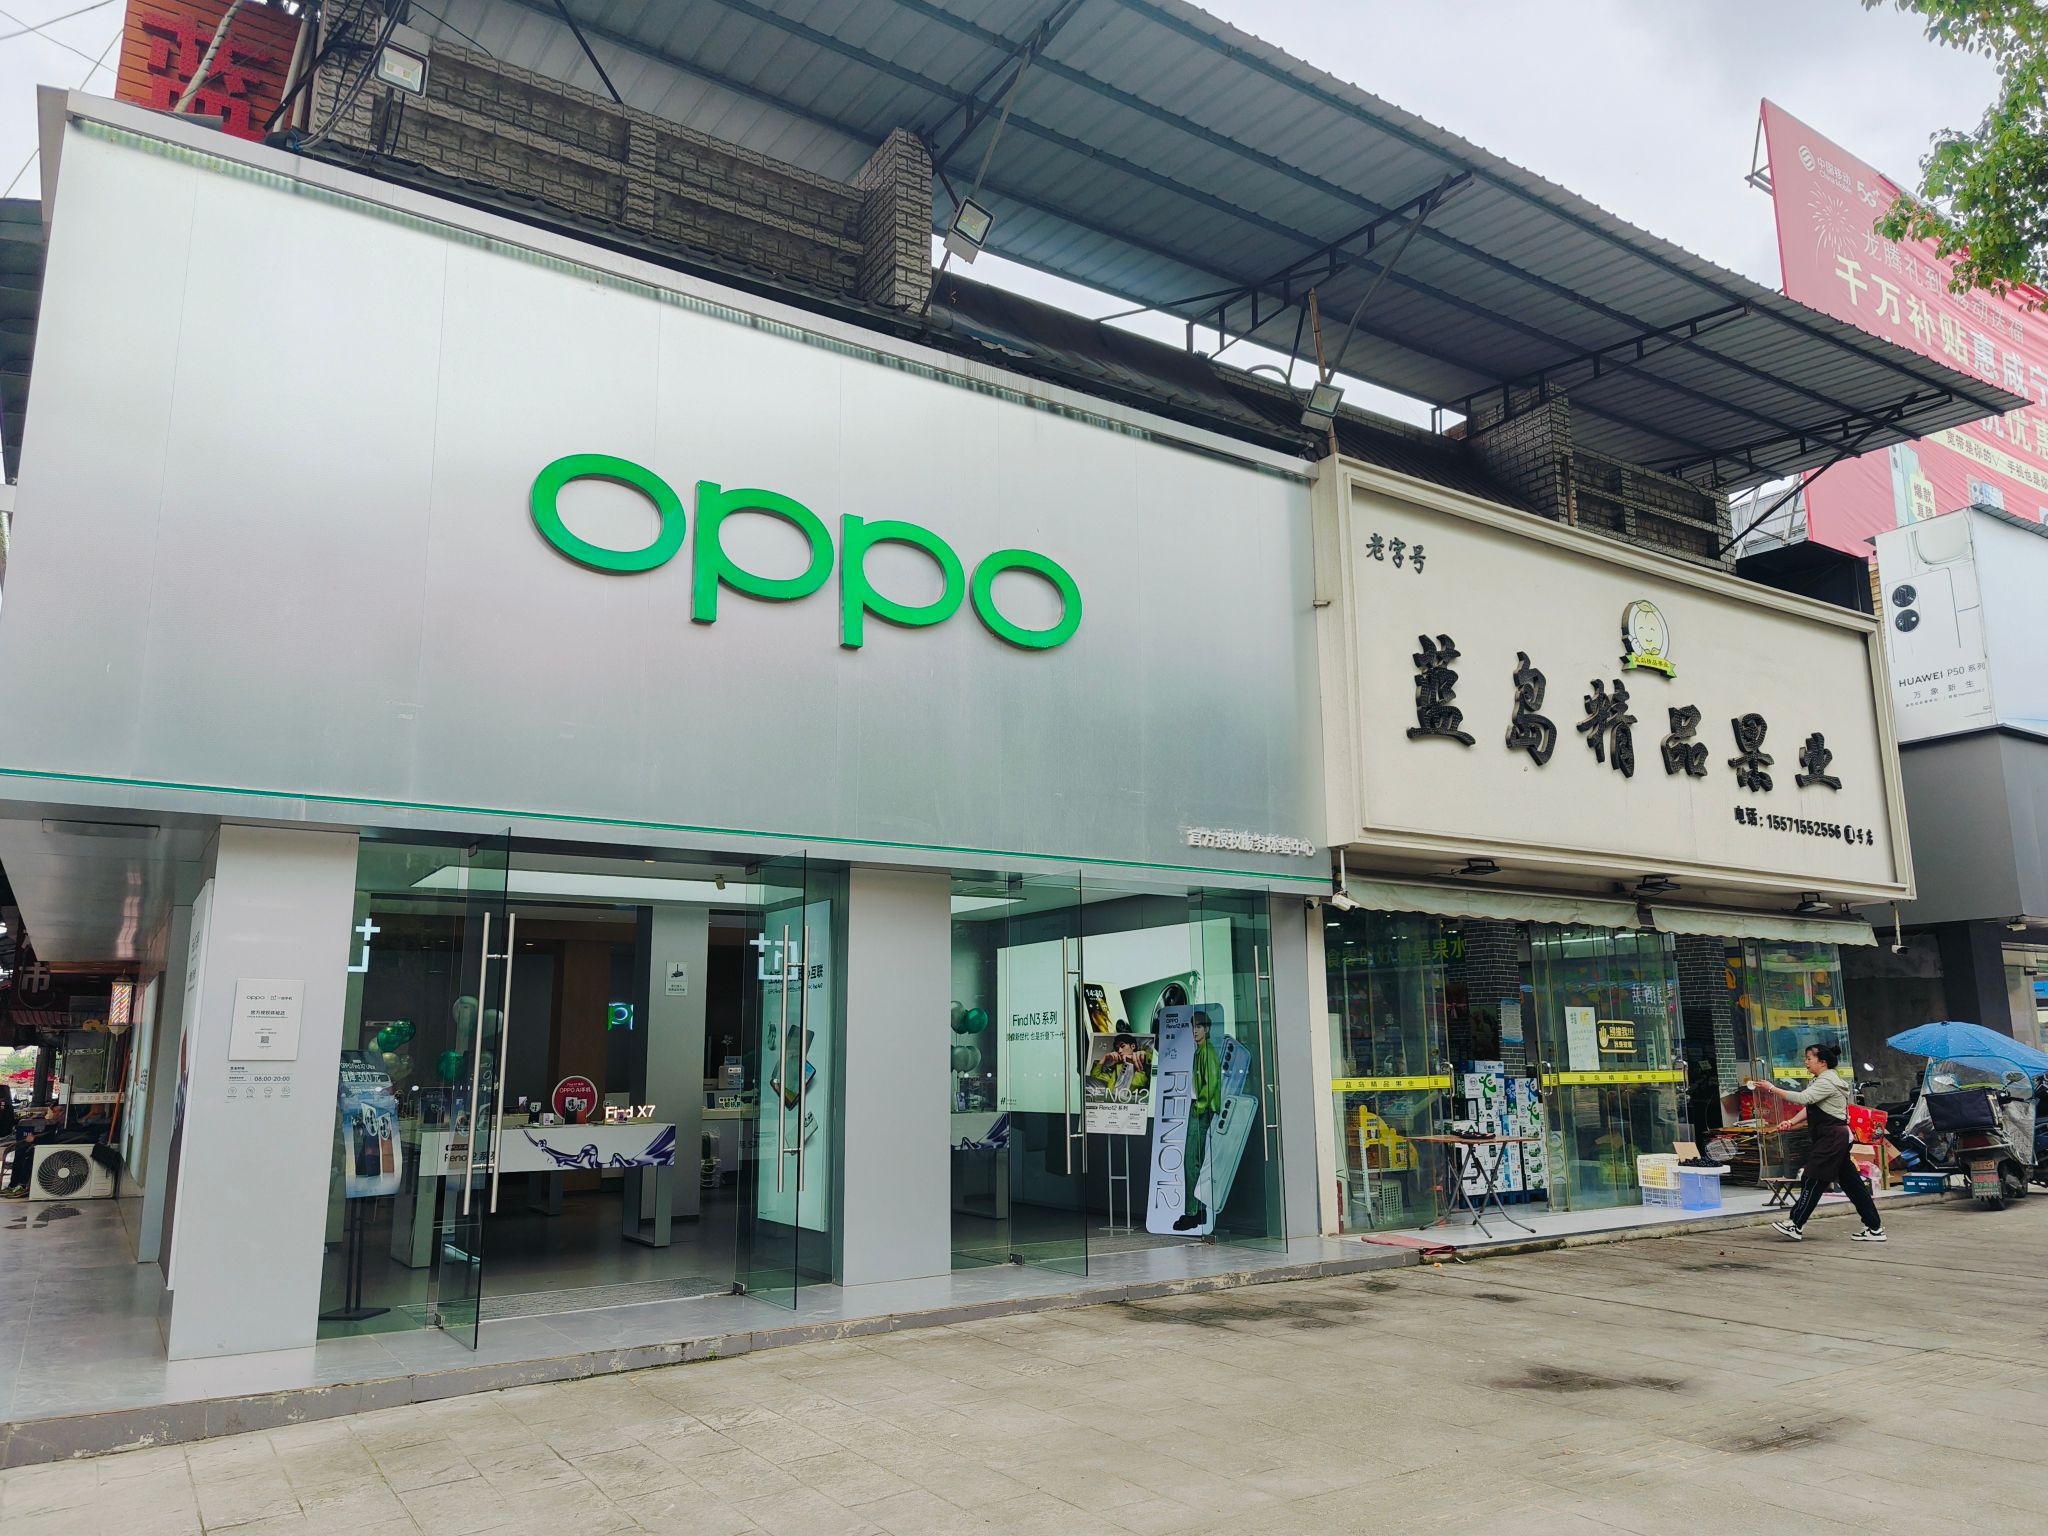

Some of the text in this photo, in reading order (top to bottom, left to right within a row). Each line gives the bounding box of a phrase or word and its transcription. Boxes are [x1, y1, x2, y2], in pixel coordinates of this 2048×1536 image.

[1817, 157, 1852, 187] 中国移动
[1862, 228, 1943, 300] 龙腾礼到
[1365, 532, 1427, 575] 老字号
[1899, 661, 1987, 688] HUAWEI P50 系列
[1913, 680, 1974, 700] 万象新生
[1012, 1011, 1058, 1026] Find N3 系列
[605, 1104, 656, 1119] Find X7
[1155, 1070, 1189, 1210] RENO12
